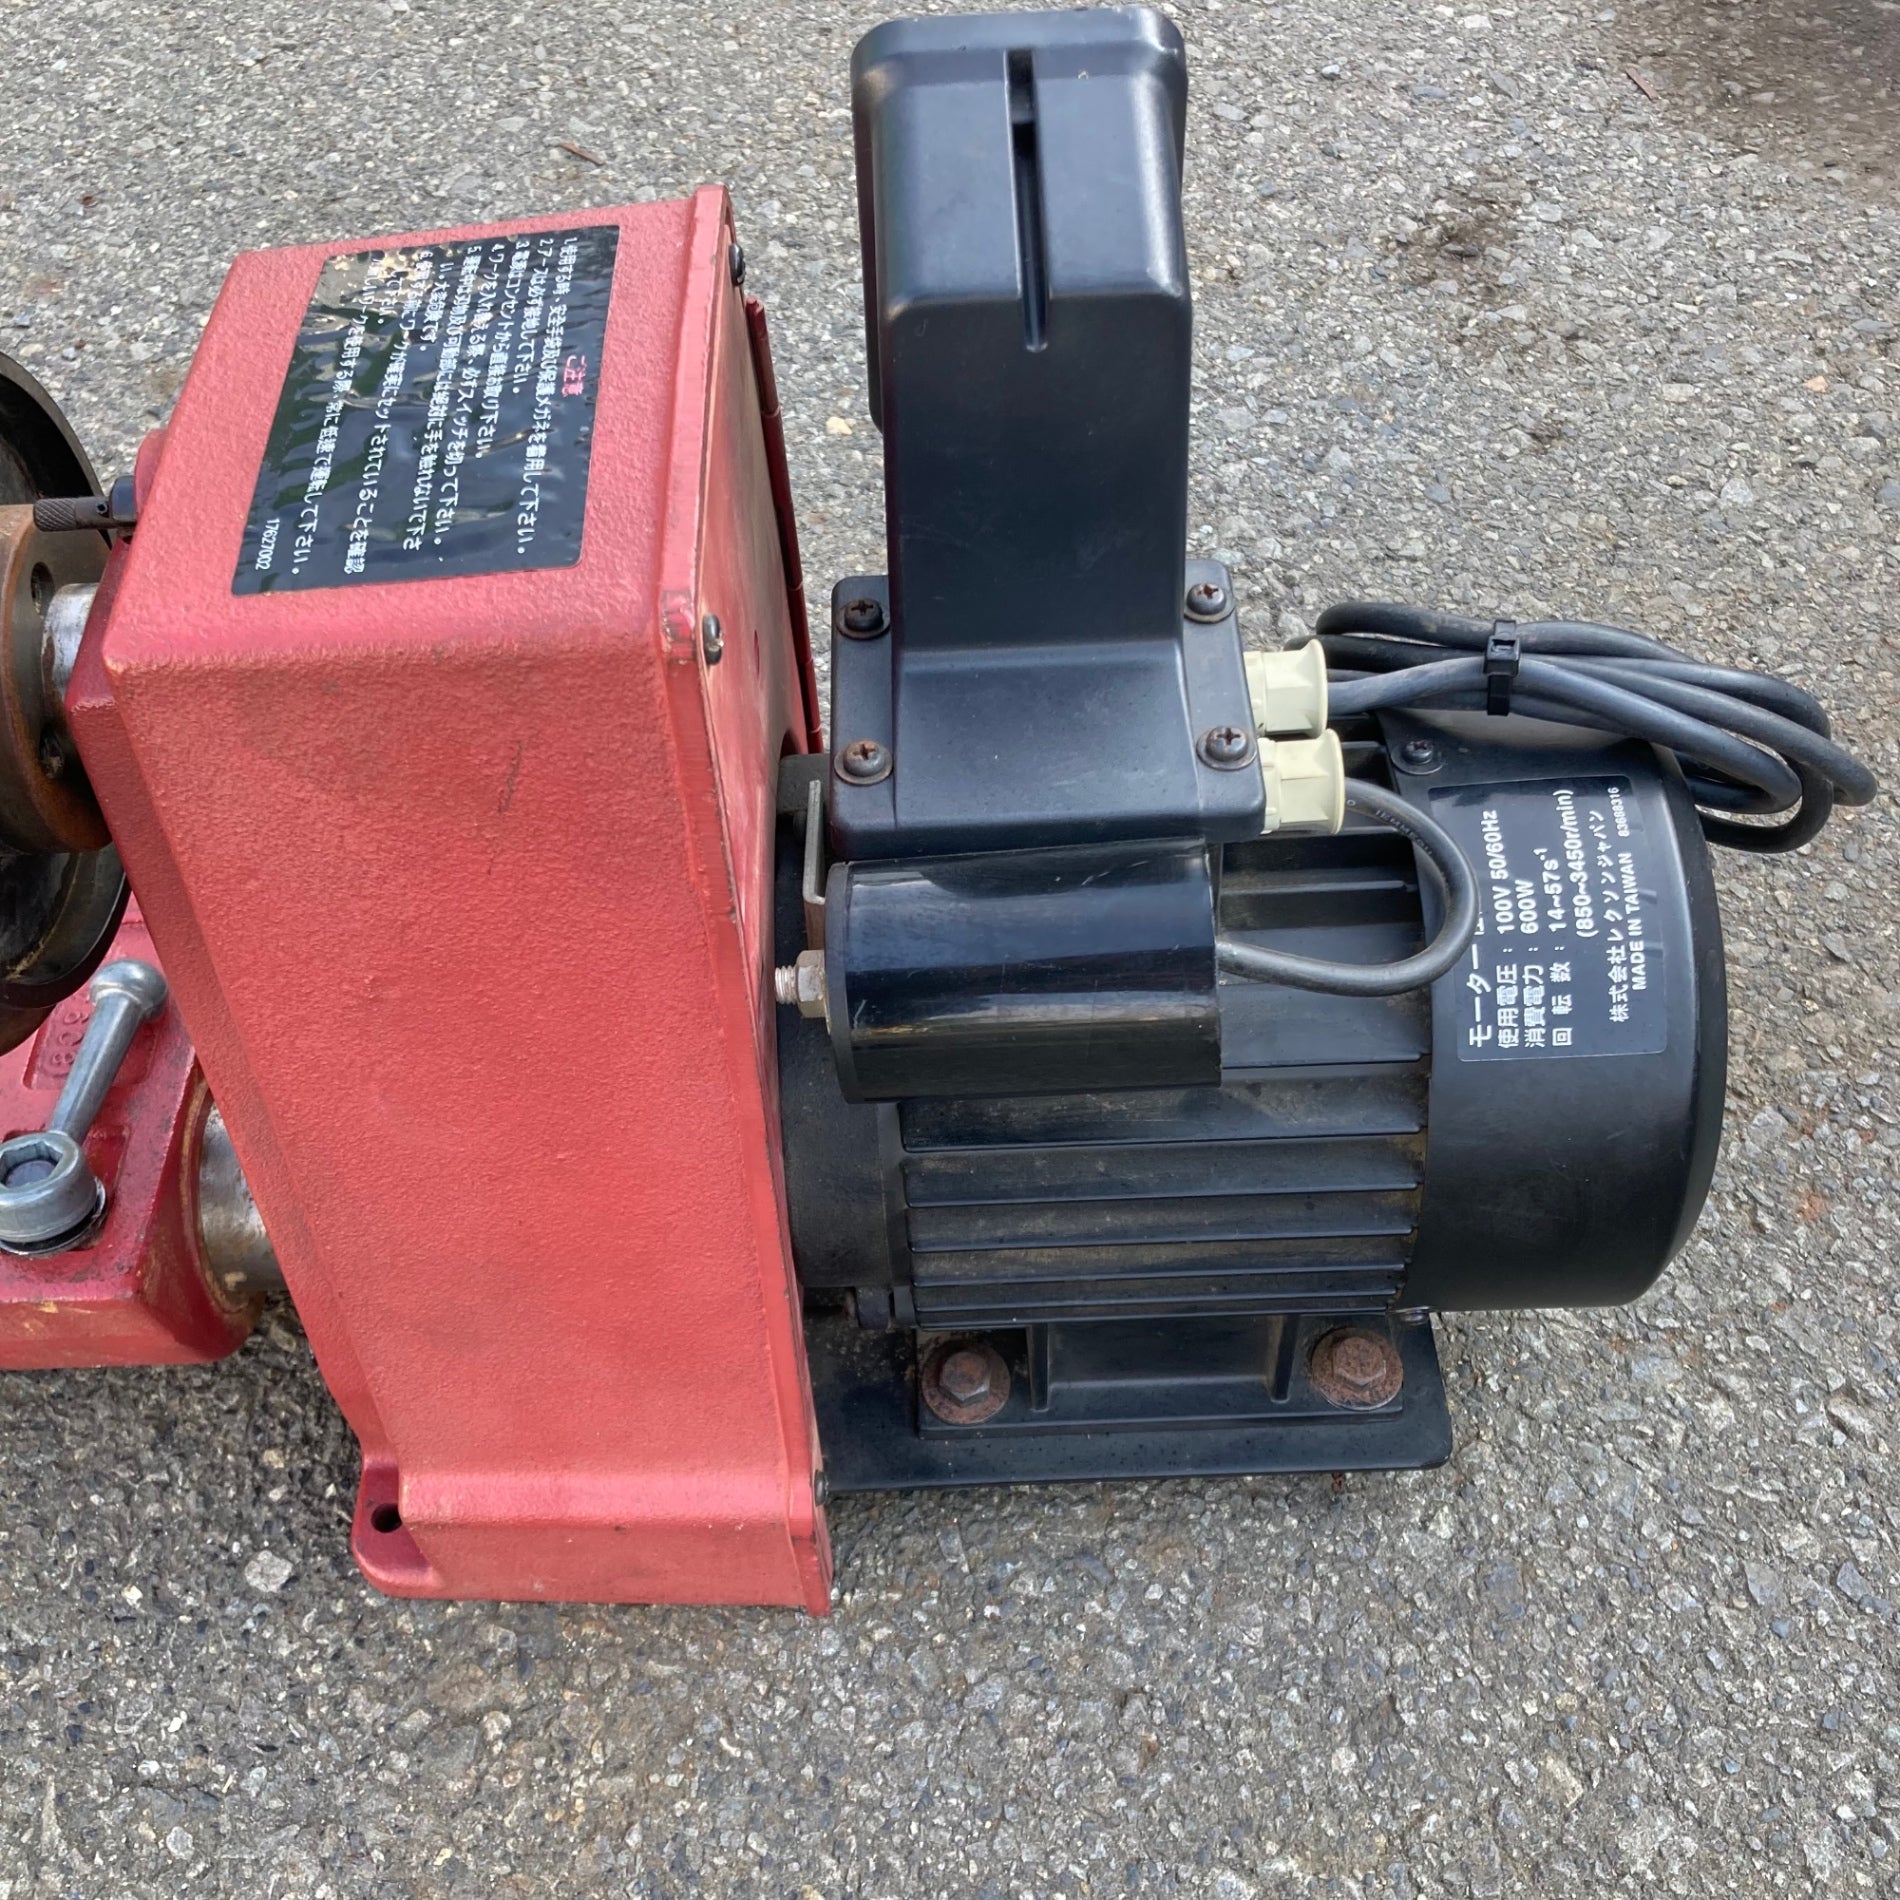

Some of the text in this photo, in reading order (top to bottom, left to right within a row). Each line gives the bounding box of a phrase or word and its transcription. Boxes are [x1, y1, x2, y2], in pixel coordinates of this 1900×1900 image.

[562, 355, 586, 397] ご注意
[255, 519, 280, 570] 17627002
[1481, 810, 1509, 880] 50/60Hz
[1515, 880, 1539, 934] 600W
[1618, 852, 1640, 914] TAIWAN
[1492, 886, 1515, 934] 100V
[1589, 810, 1630, 1022] 株式会社レクソンジャパン
[1628, 919, 1642, 936] IN
[1630, 940, 1647, 991] MADE
